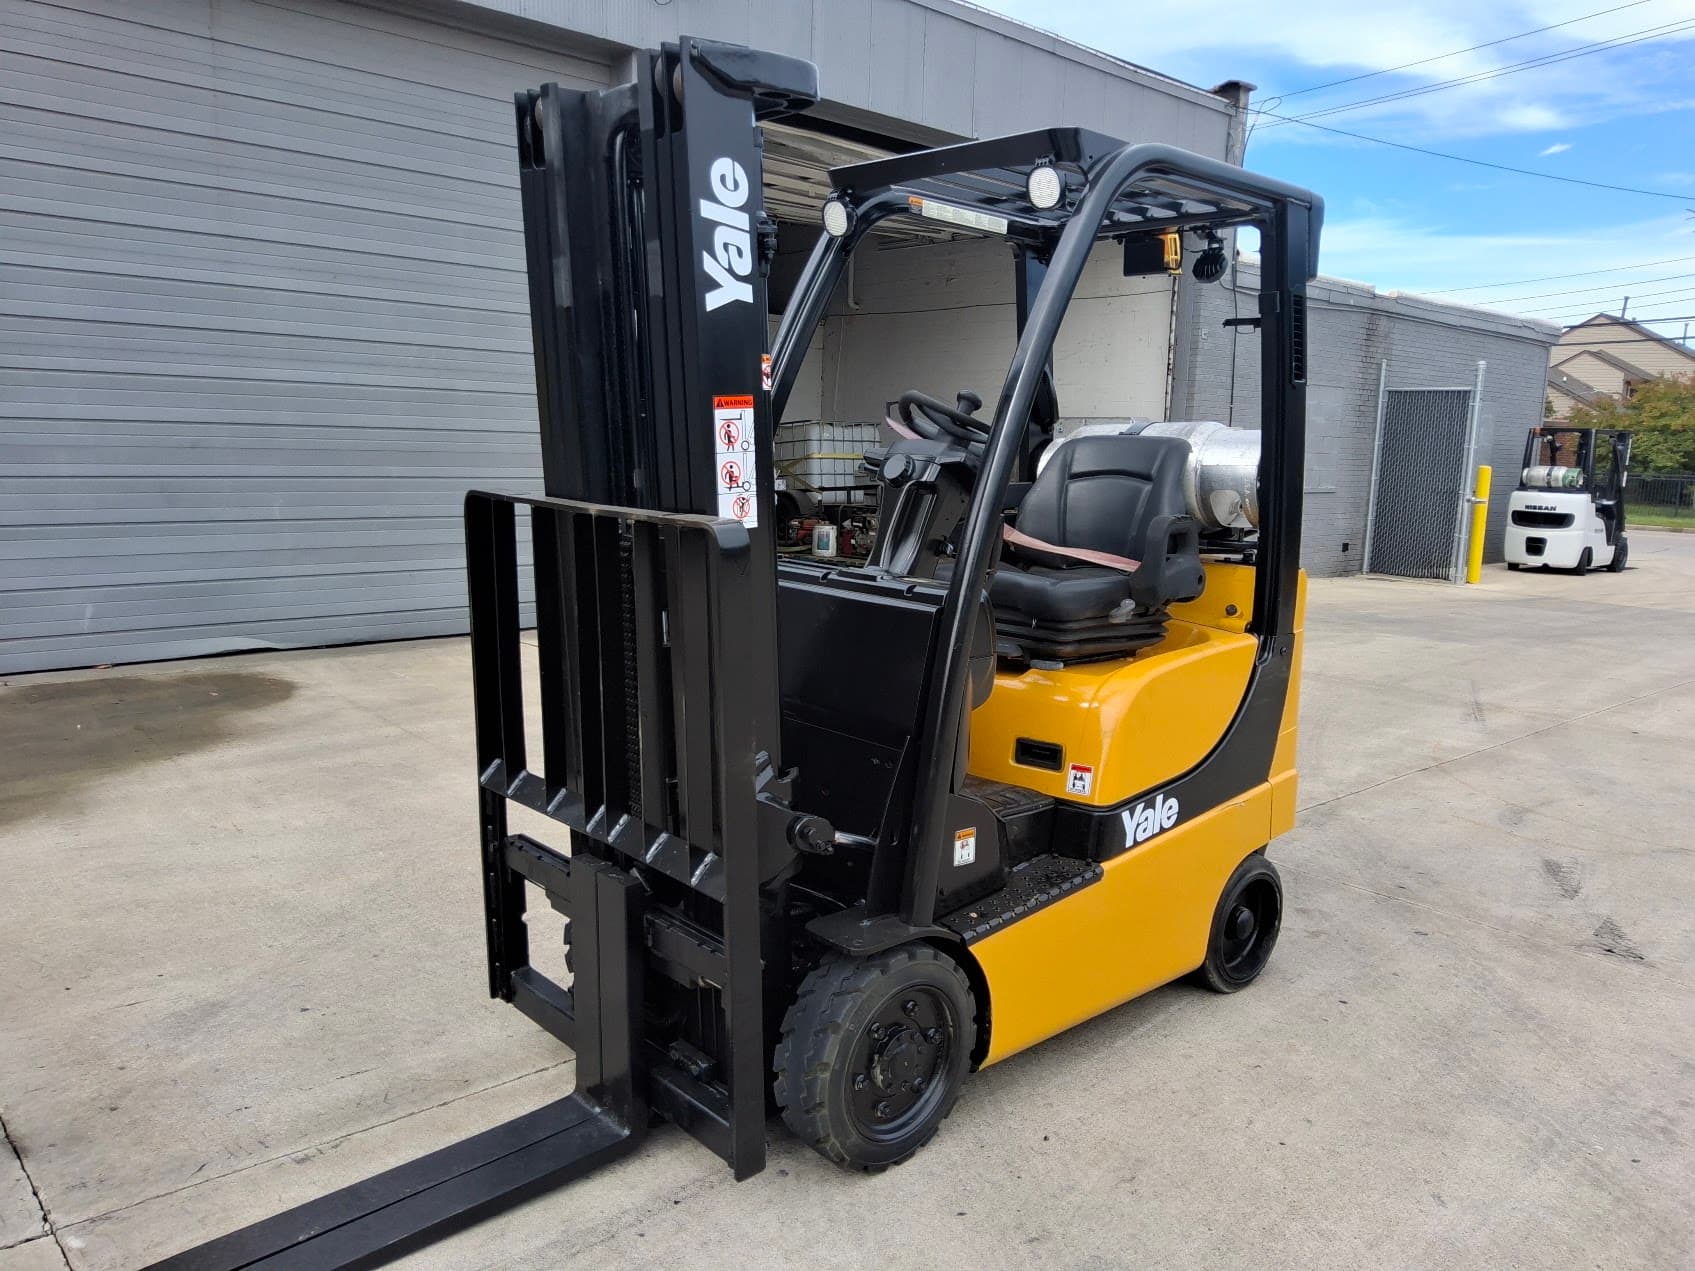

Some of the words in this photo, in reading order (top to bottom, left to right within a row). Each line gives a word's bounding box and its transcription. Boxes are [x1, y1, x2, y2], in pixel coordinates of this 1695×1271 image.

[699, 157, 754, 312] Yale
[724, 399, 753, 407] WARNING
[1524, 504, 1557, 512] NISSAN
[1121, 793, 1179, 849] Yale
